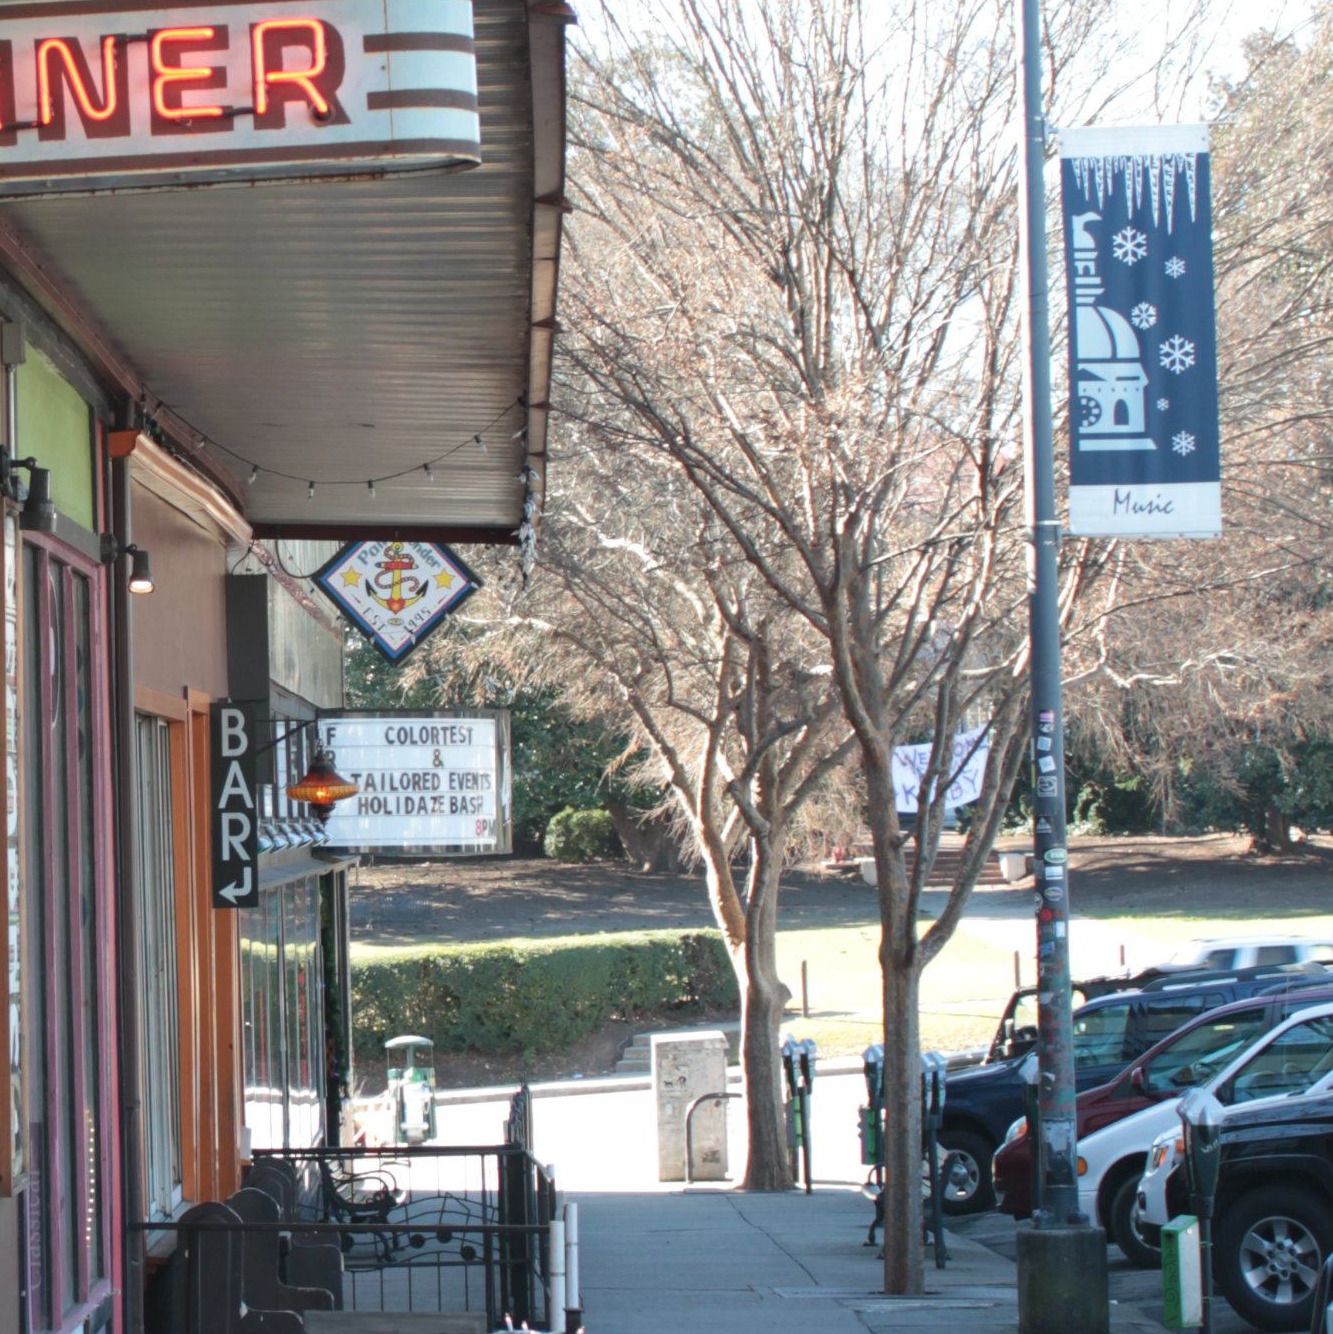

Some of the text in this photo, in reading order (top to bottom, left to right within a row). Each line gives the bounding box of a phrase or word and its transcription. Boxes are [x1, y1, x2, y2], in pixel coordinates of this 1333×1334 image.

[1113, 487, 1174, 515] Music
[384, 726, 474, 746] COLORTEST
[432, 748, 444, 768] &
[218, 708, 254, 861] BAR
[350, 772, 492, 791] TAILORED EVENTS
[357, 795, 484, 816] HOLIDAZE BASH
